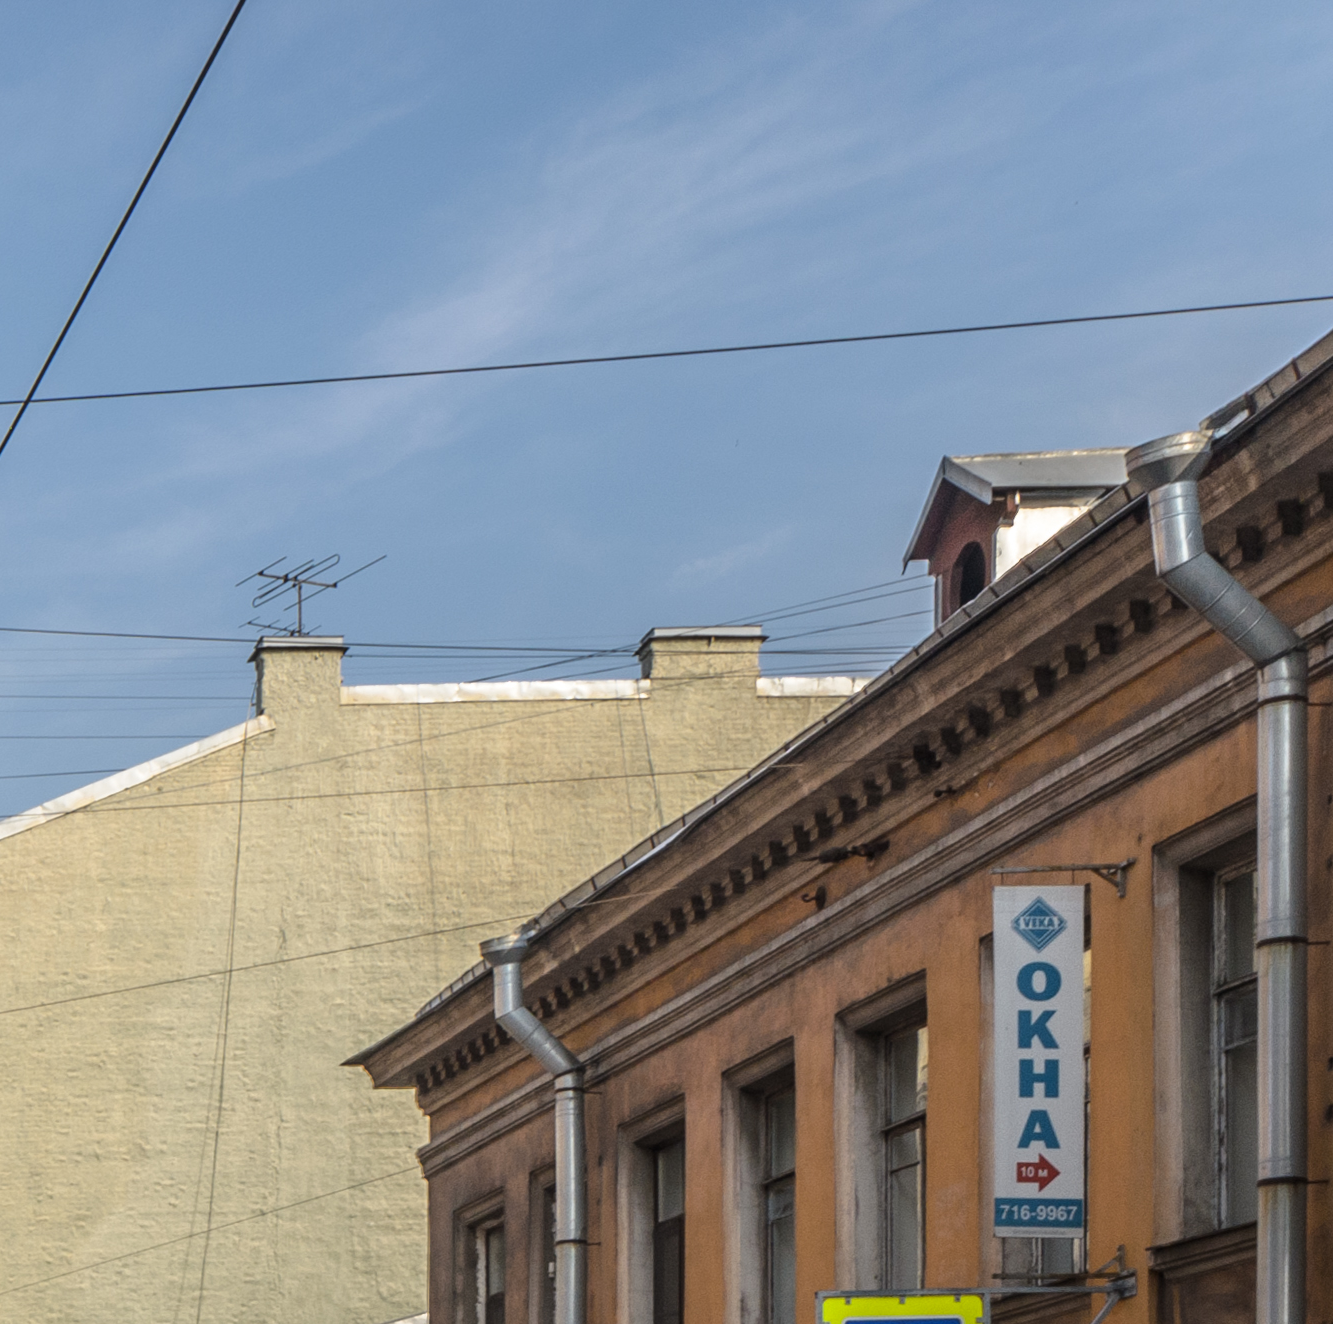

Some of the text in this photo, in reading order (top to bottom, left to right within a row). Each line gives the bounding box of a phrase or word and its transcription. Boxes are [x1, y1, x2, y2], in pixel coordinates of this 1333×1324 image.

[1022, 916, 1056, 928] VEKA
[1016, 961, 1061, 1150] ОКНА
[1020, 1166, 1035, 1178] 10
[999, 1205, 1078, 1221] 716-9967
